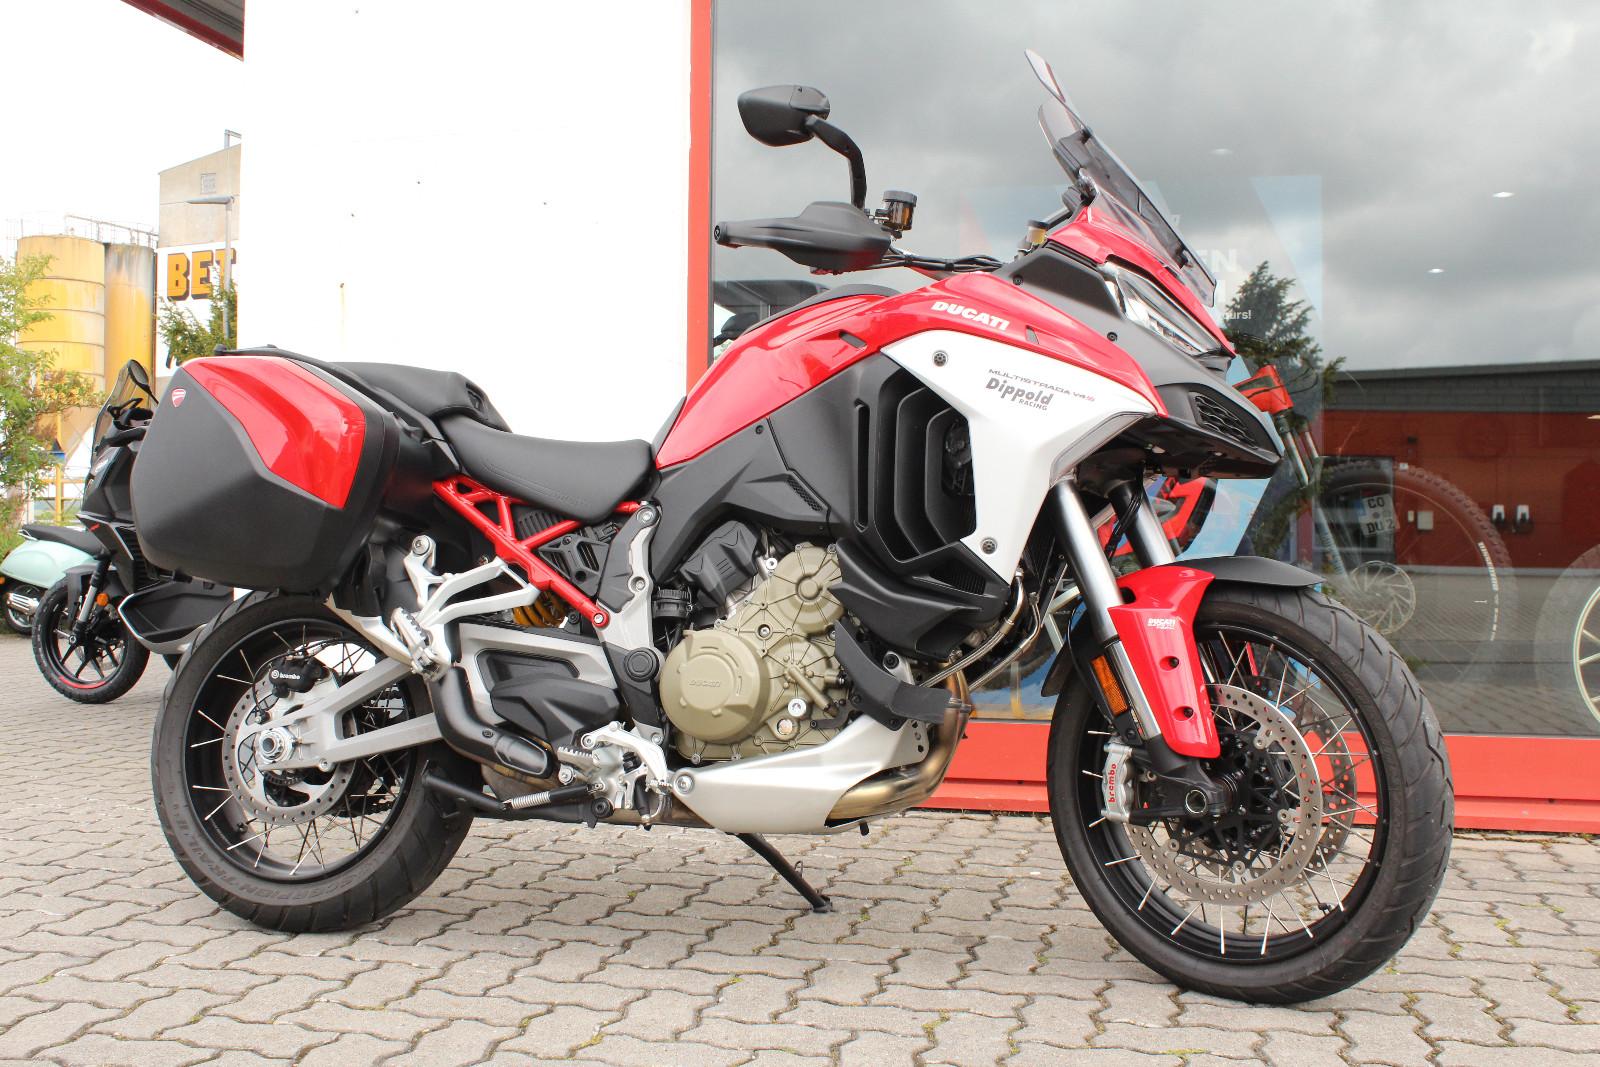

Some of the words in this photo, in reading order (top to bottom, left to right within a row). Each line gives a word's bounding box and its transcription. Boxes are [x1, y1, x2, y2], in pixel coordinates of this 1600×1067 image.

[930, 301, 1010, 332] DUCATI
[985, 377, 1055, 405] Dippold
[988, 368, 1071, 395] MULTISTRADA
[1018, 398, 1048, 411] RACING
[279, 672, 301, 680] brembo
[1108, 763, 1117, 803] brembo
